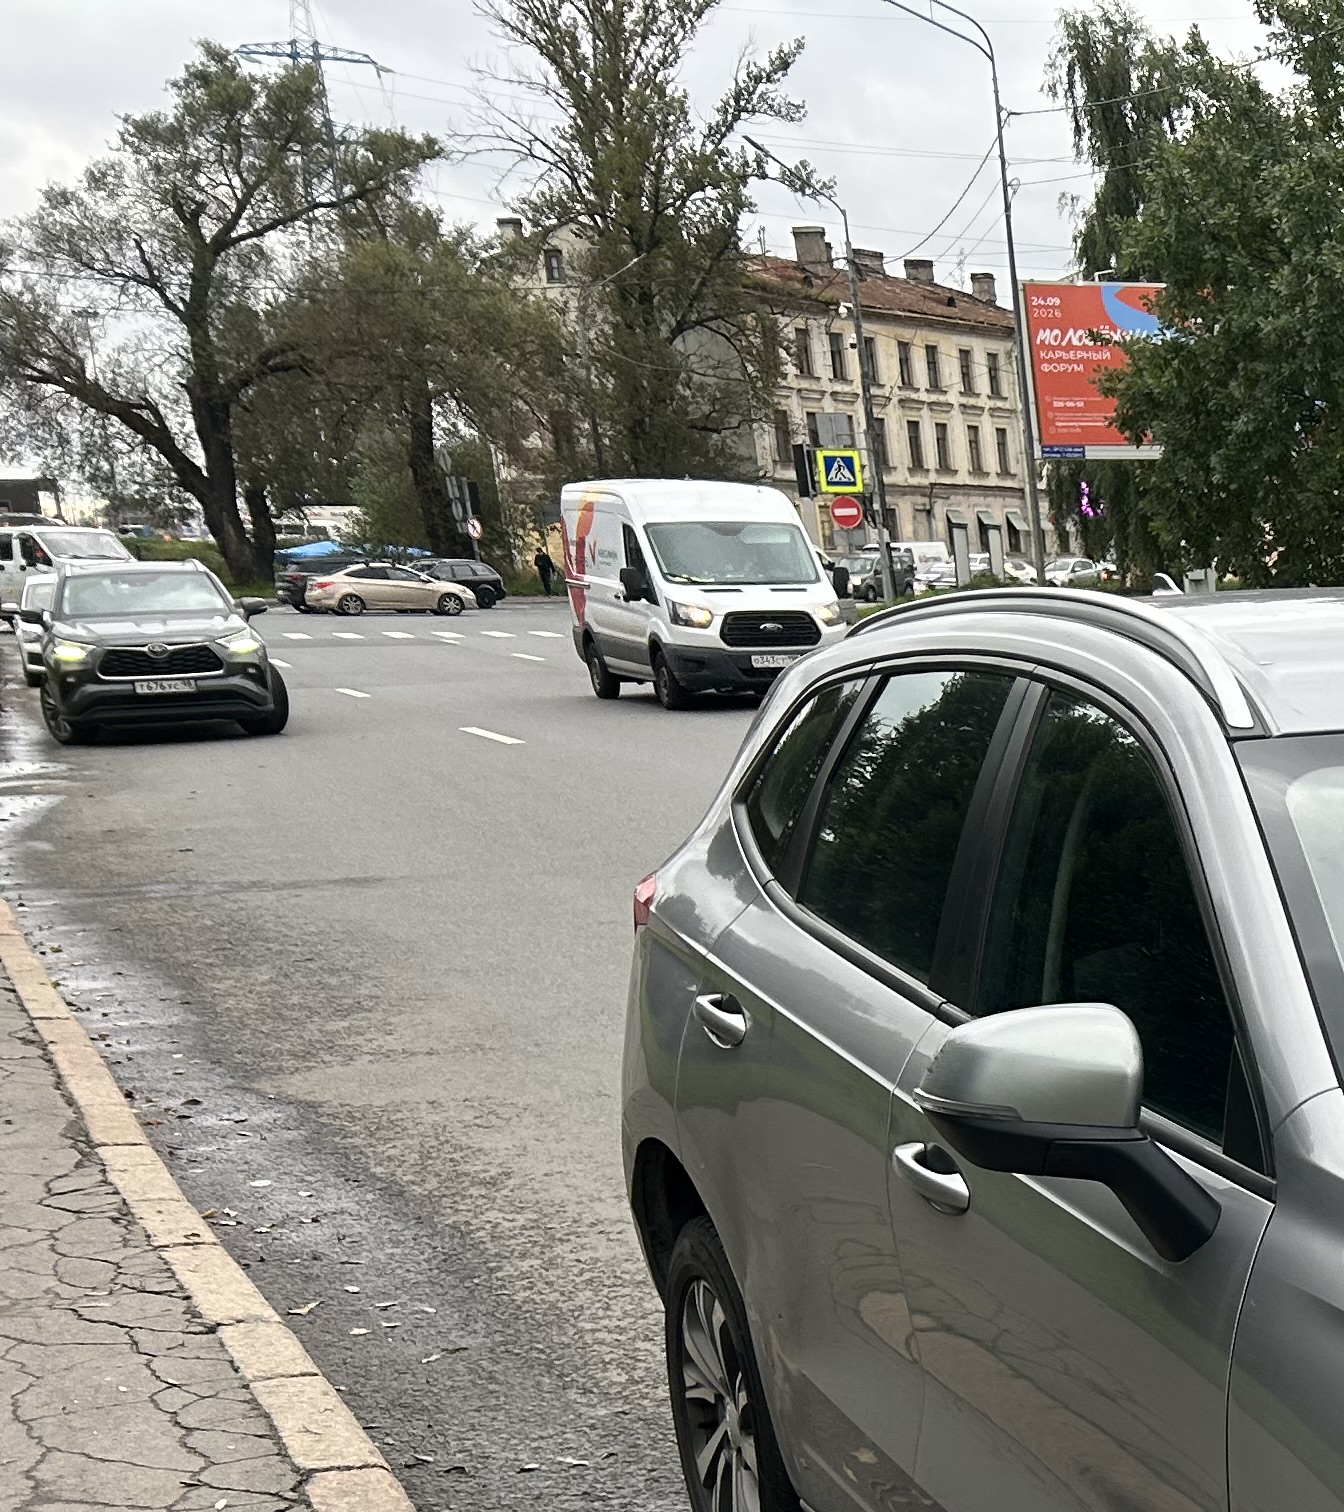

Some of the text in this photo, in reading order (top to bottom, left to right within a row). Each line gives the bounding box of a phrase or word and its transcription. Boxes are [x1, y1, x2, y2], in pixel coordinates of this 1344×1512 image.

[1031, 296, 1061, 306] 24.09
[1040, 348, 1111, 360] КАРЬЕРНЫЙ
[1040, 362, 1084, 373] ФОРУМ
